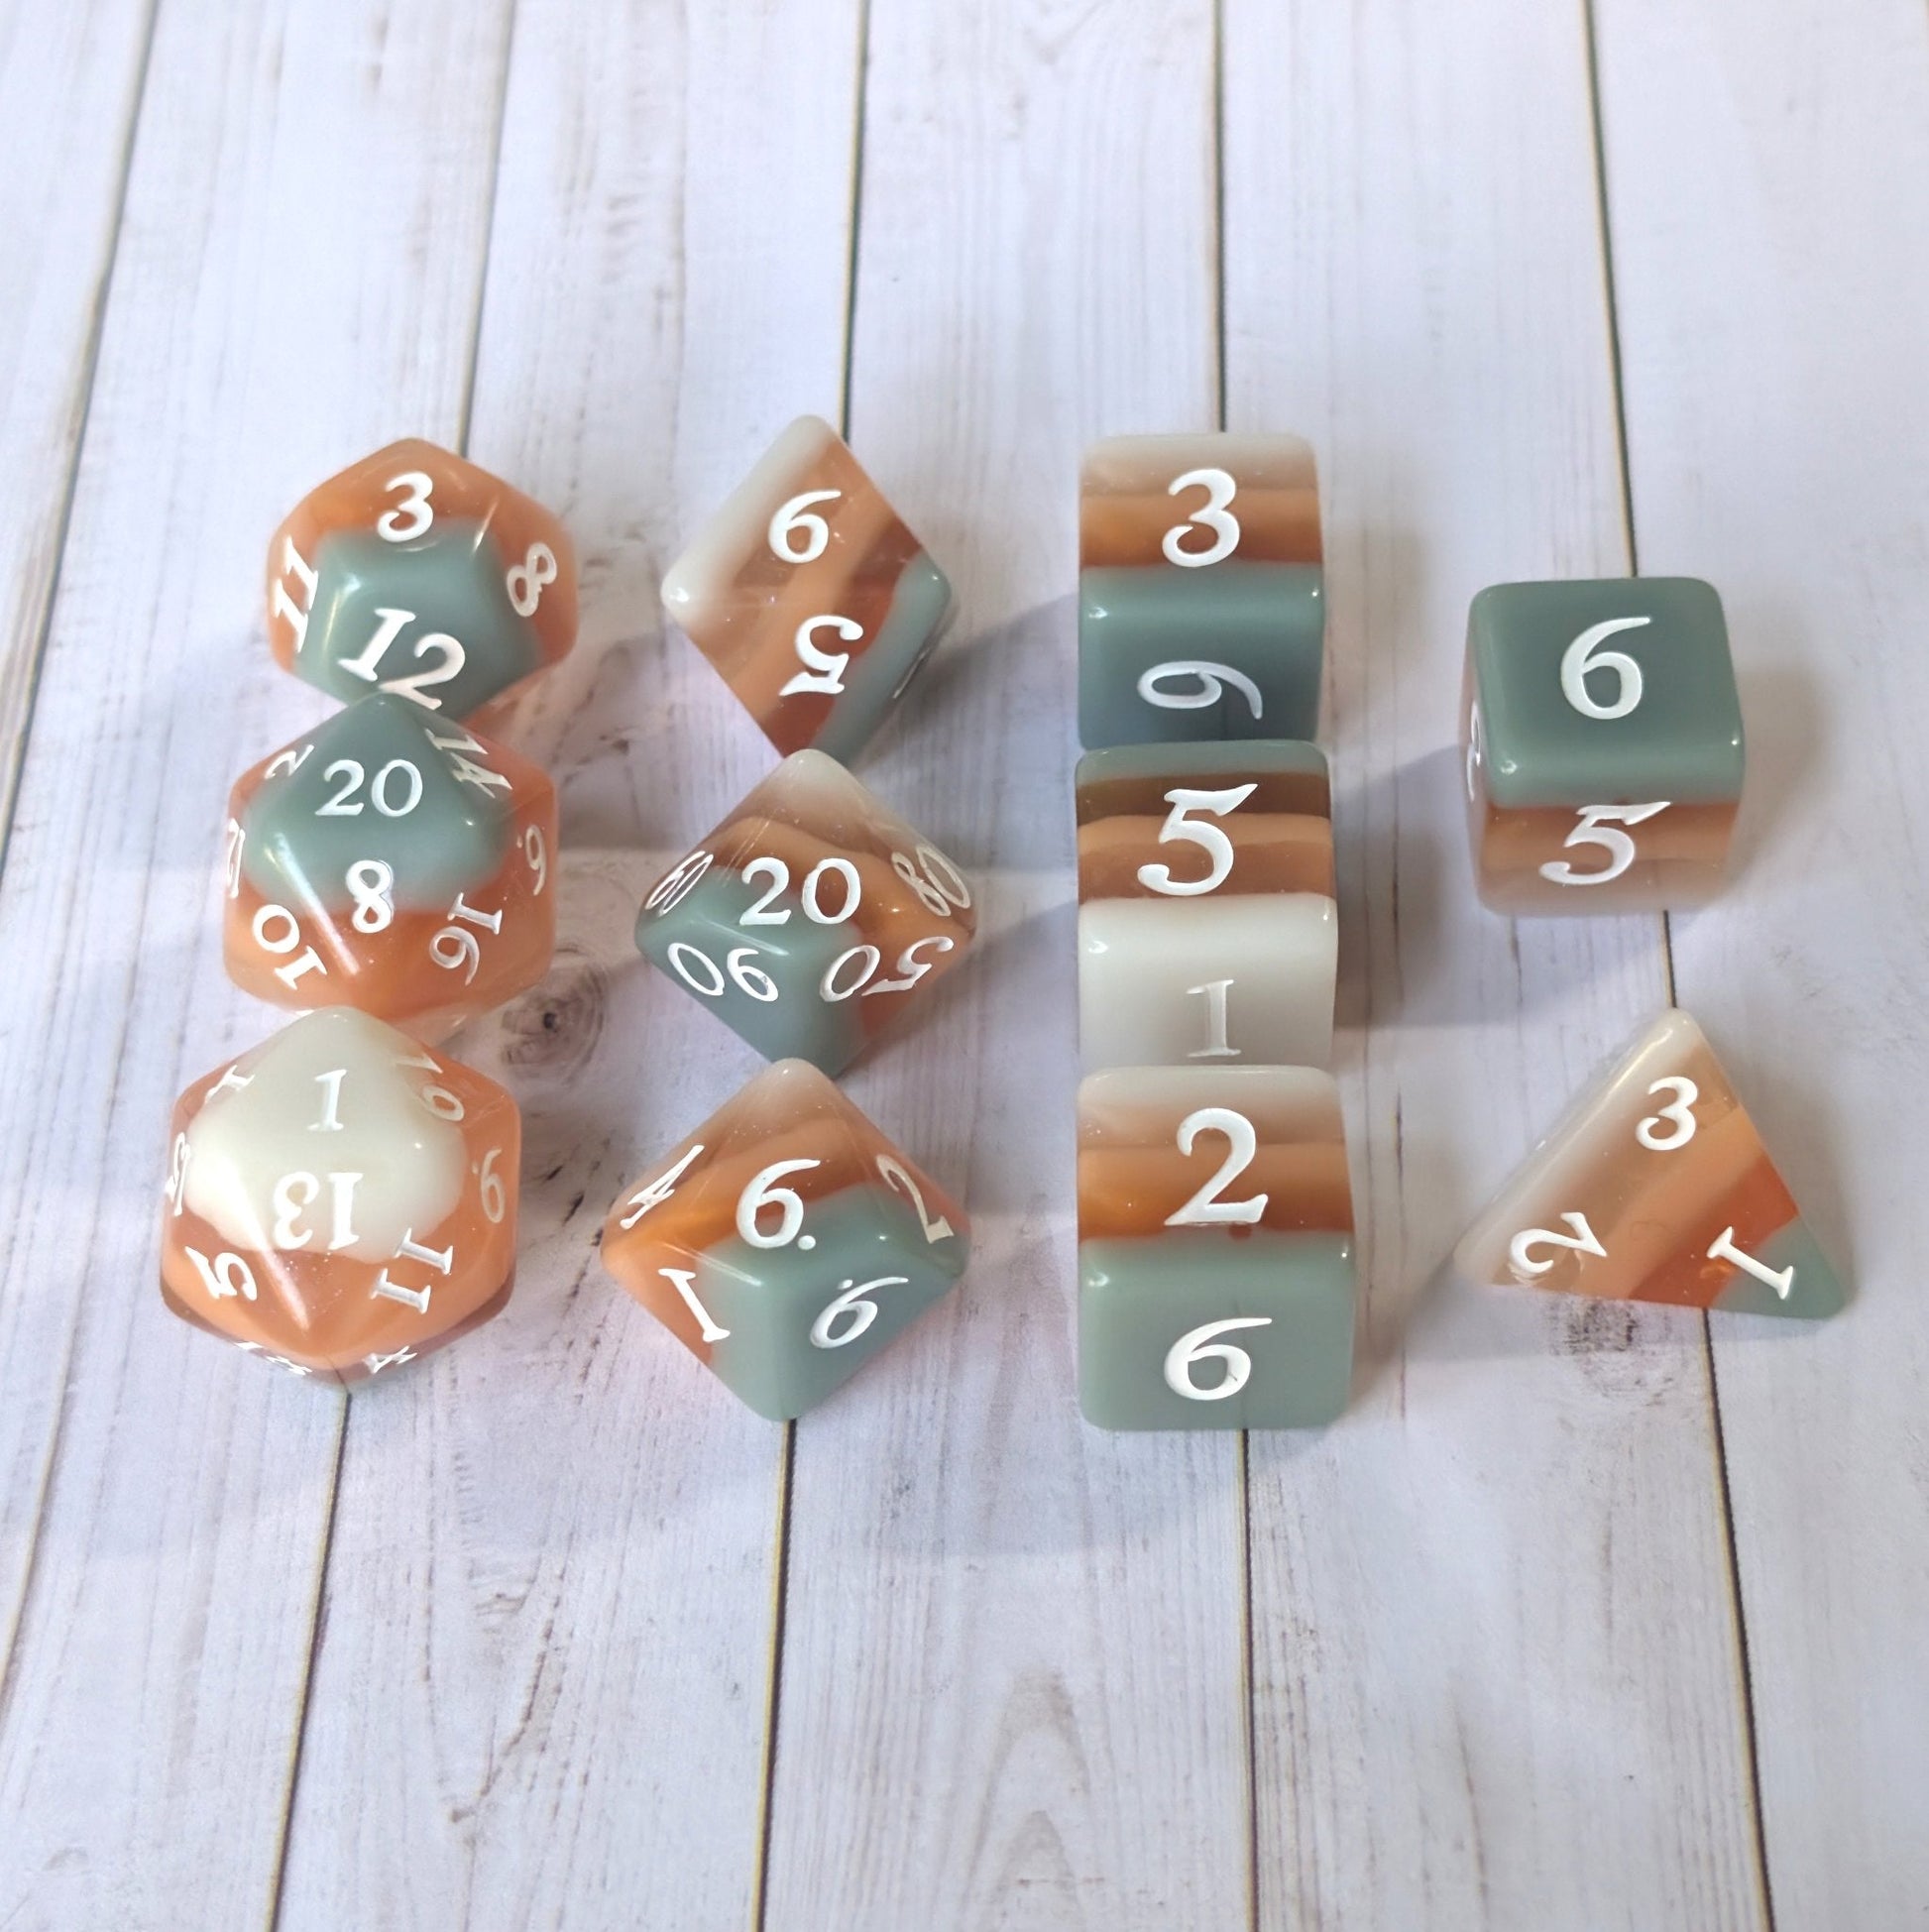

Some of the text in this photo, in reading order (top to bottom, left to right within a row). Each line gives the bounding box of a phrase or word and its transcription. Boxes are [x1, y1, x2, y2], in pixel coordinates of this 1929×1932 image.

[377, 471, 434, 542] 3
[768, 489, 842, 564] 6
[1162, 468, 1240, 567] 3
[507, 542, 558, 618] 8
[337, 608, 466, 711] 12
[778, 615, 864, 697] 5
[1559, 616, 1652, 720] 6
[314, 758, 423, 817] 20
[1137, 783, 1259, 896] 5
[1538, 801, 1672, 885] 5
[347, 859, 395, 933] 8
[738, 856, 861, 926] 20
[253, 904, 327, 990] 10
[1186, 978, 1241, 1058] 1
[307, 1069, 347, 1132] 1
[1636, 1076, 1698, 1151] 3
[876, 1155, 955, 1244] 2
[1164, 1107, 1269, 1226] 2
[273, 1171, 364, 1250] 13
[1510, 1211, 1607, 1274] 2
[184, 1245, 258, 1301] 5
[1706, 1225, 1794, 1301] 1
[658, 1268, 731, 1342] 1
[1164, 1317, 1273, 1401] 6
